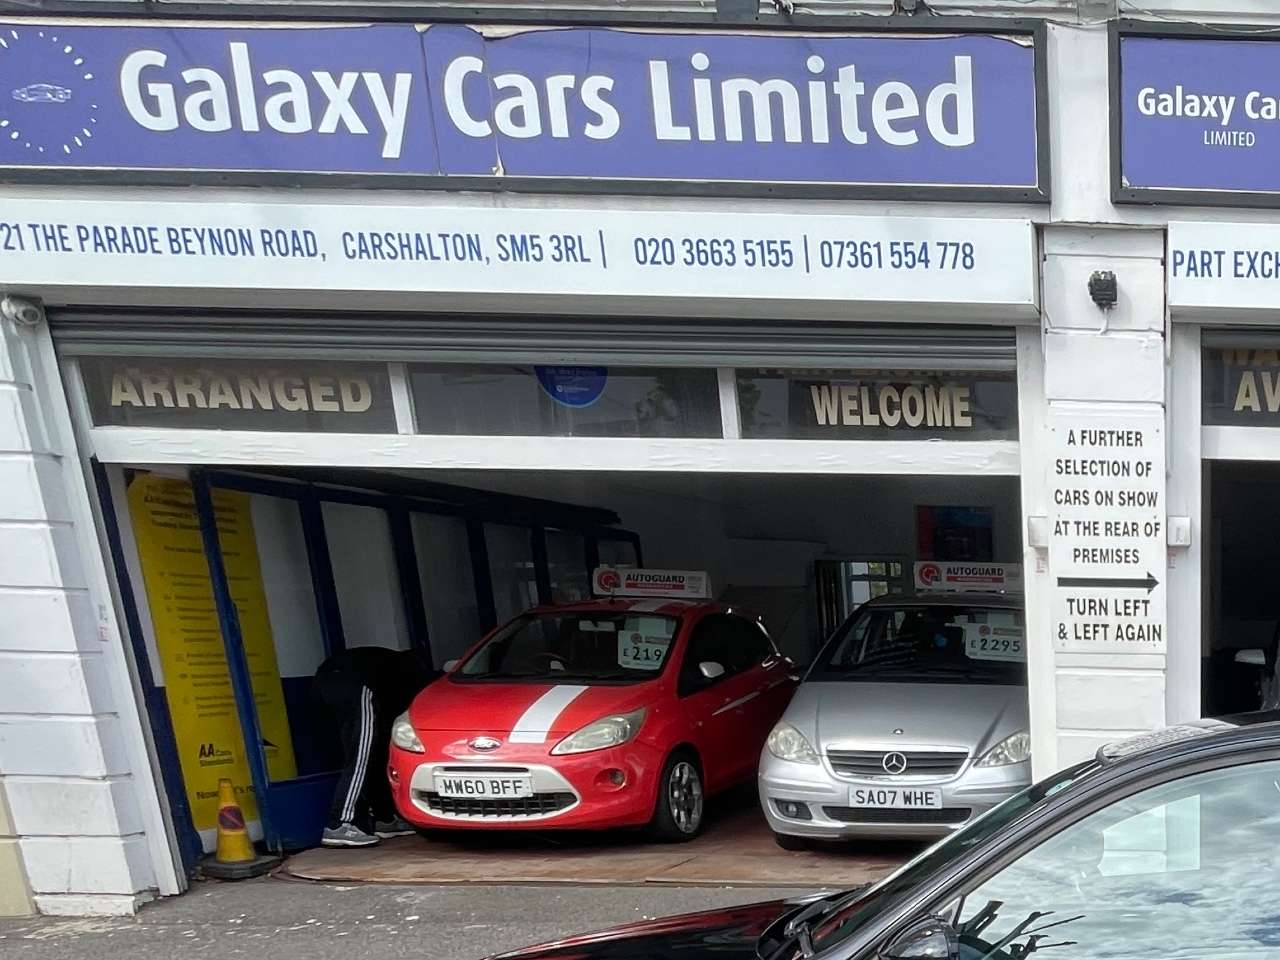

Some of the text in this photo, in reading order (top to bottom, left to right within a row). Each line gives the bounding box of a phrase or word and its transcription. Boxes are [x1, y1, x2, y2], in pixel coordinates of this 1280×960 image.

[119, 42, 976, 159] Galaxy Cars Limited
[1137, 86, 1233, 125] Galaxy
[1203, 130, 1256, 148] LIMITED
[1, 223, 591, 266] 21 THE PARADE BEYNON ROAD, CARSHALTON, SM5 3RL
[634, 237, 793, 268] 020 3663 5155
[820, 241, 975, 271] 07361 554 778
[1172, 249, 1226, 279] PART
[111, 372, 373, 413] ARRANGED
[811, 385, 972, 427] WELCOME
[1067, 429, 1144, 447] A FURTHER
[1055, 458, 1152, 478] SELECTION OF
[1054, 489, 1159, 508] CARS ON SHOW
[1054, 520, 1161, 538] AT THE REAR OF
[1073, 548, 1140, 564] PREMISES
[625, 573, 686, 584] AUTOGUARD
[946, 567, 1004, 576] AUTOGUARD
[1066, 598, 1151, 617] TURN LEFT
[1058, 623, 1163, 642] & LEFT AGAIN
[199, 743, 215, 758] AA
[442, 778, 523, 795] MW60 BFF
[855, 789, 935, 807] SA07 WHE
